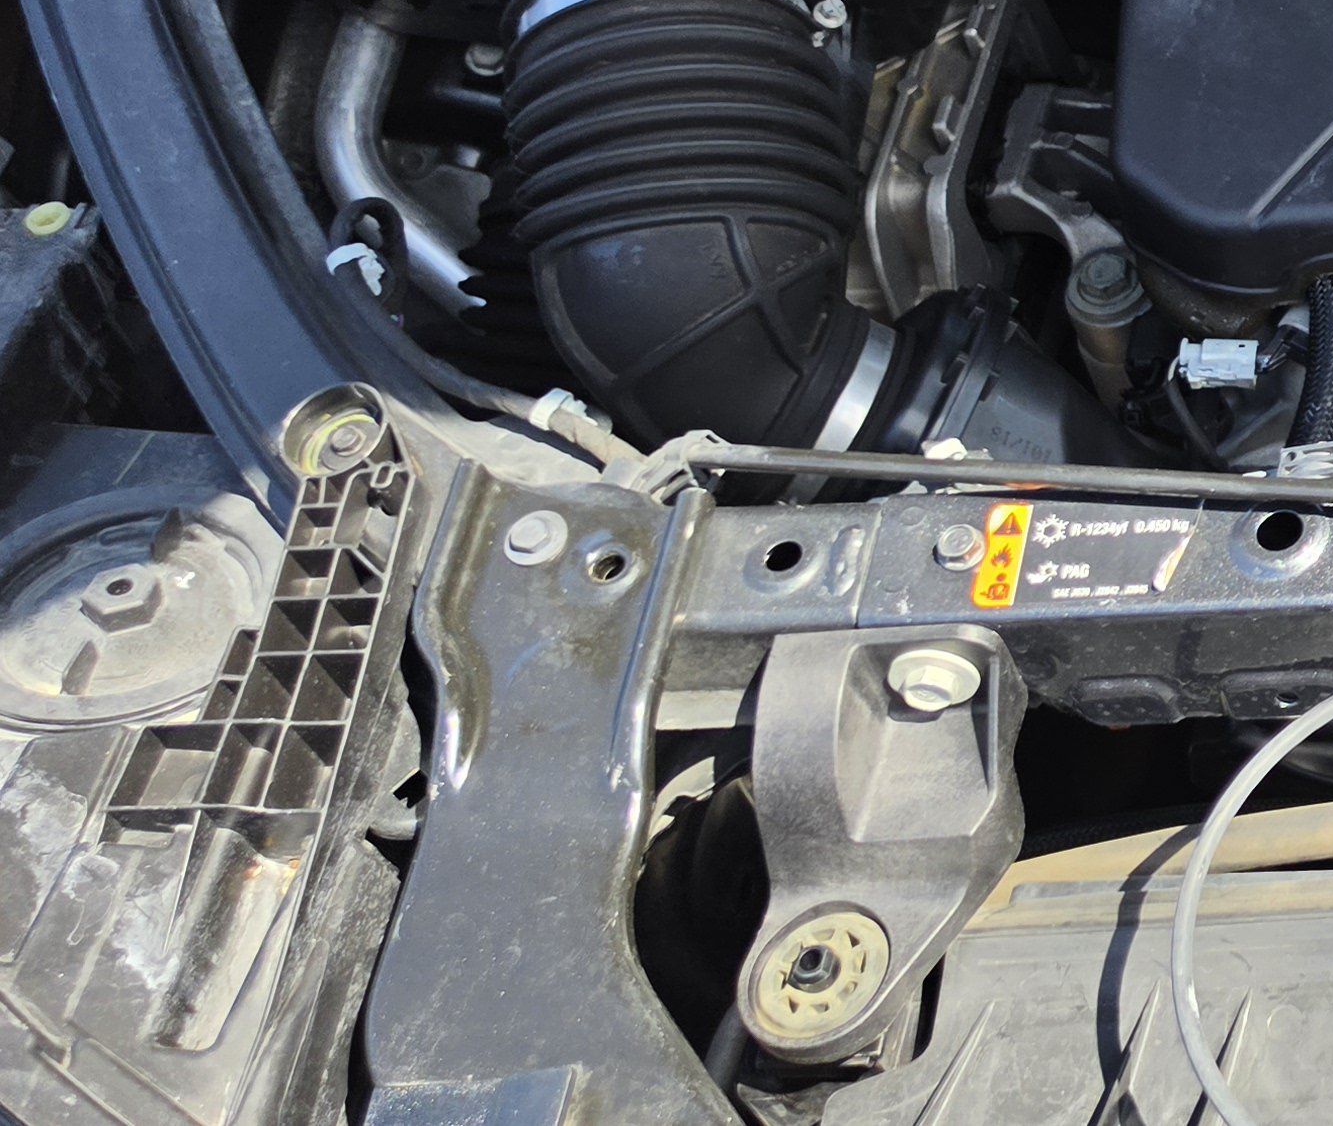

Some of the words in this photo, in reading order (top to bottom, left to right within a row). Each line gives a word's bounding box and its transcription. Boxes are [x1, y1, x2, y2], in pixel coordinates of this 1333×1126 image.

[1070, 520, 1130, 536] R-1234yf
[1134, 519, 1171, 534] 0.450
[1172, 518, 1190, 534] kg
[1060, 564, 1091, 580] PAG
